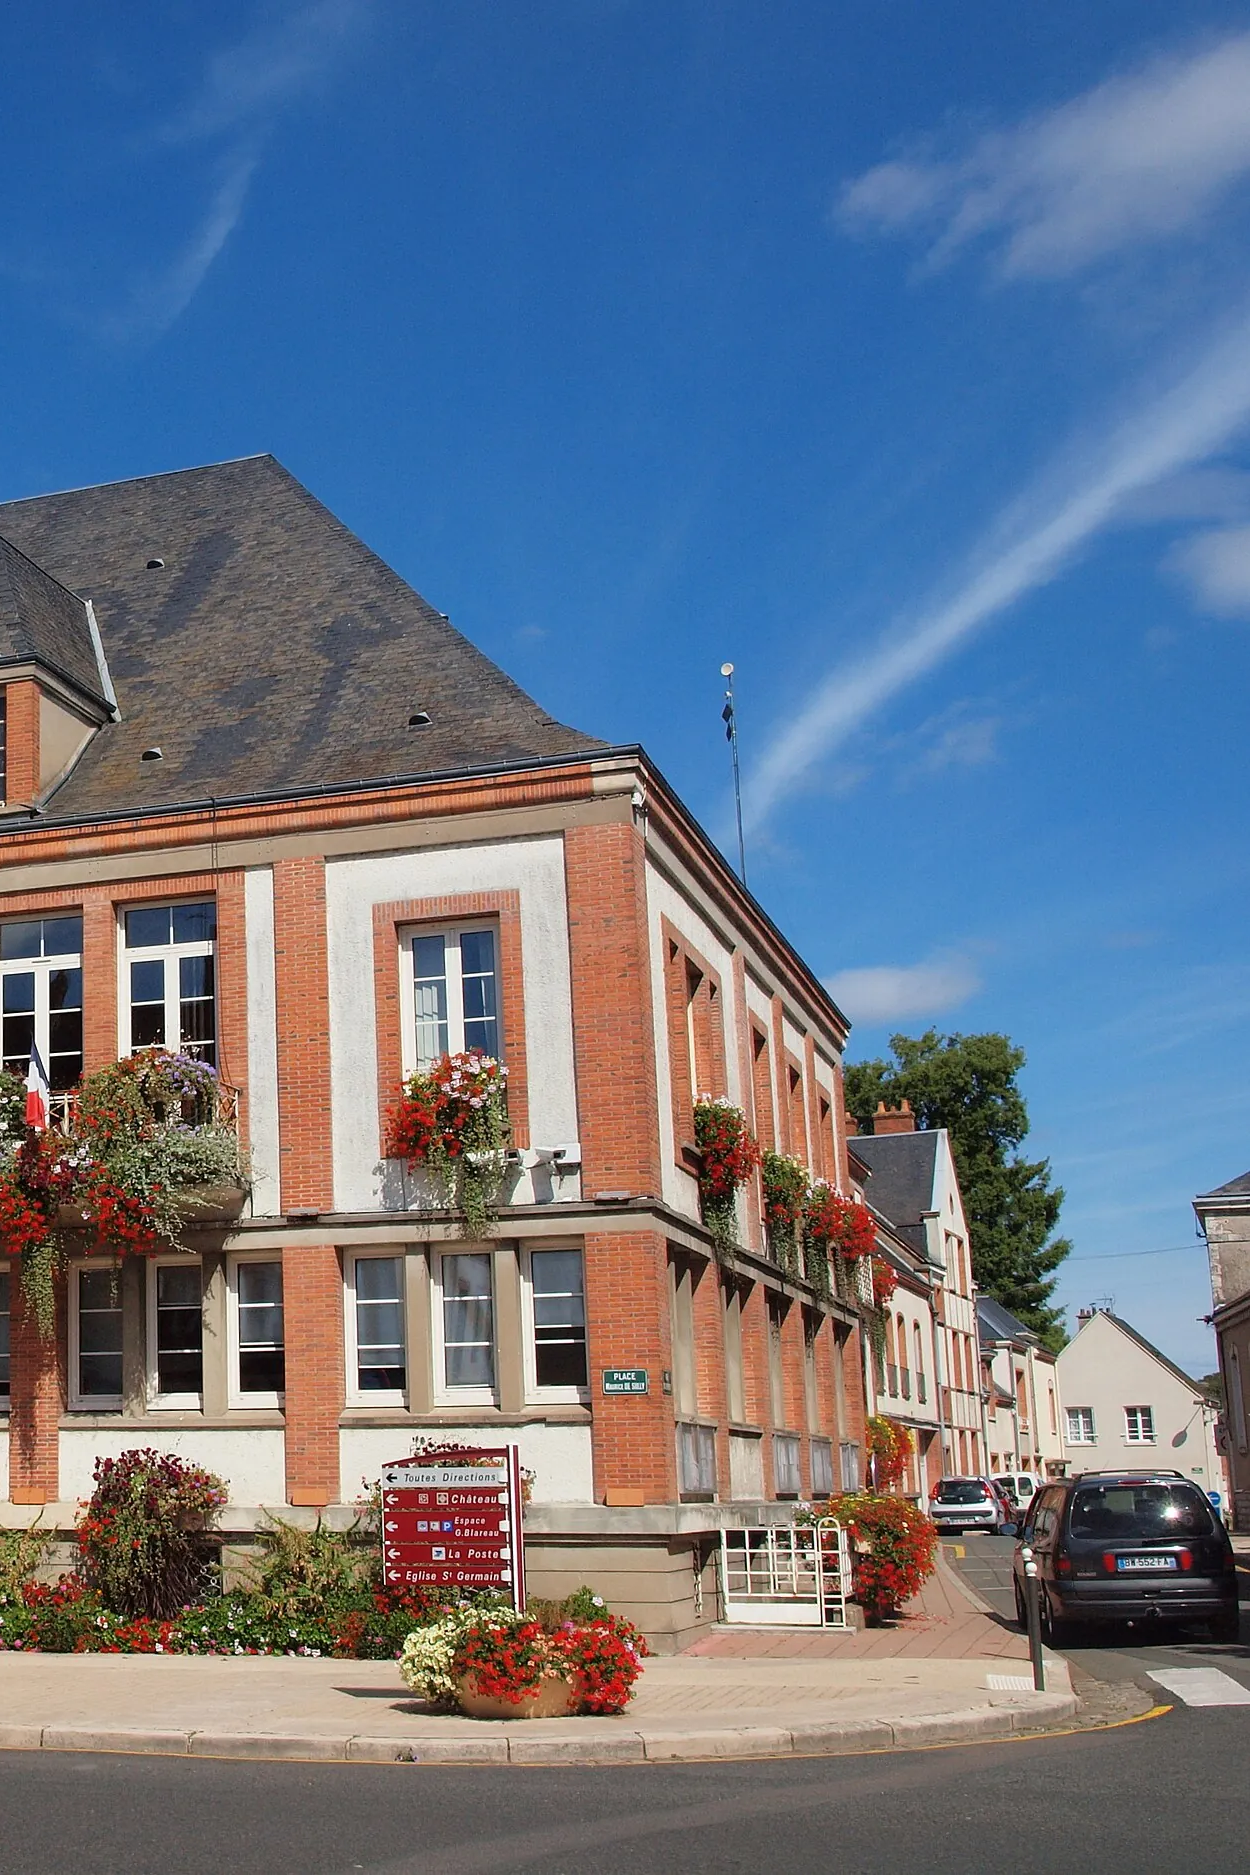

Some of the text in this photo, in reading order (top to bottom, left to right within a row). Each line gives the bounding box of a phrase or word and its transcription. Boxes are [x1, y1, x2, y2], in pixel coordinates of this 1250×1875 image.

[613, 1372, 636, 1381] PLACE
[404, 1472, 496, 1483] Toutes Directions
[451, 1494, 497, 1504] Château
[454, 1516, 486, 1526] Espace
[448, 1549, 499, 1558] La Poste
[406, 1571, 500, 1583] Eglise St Germain
